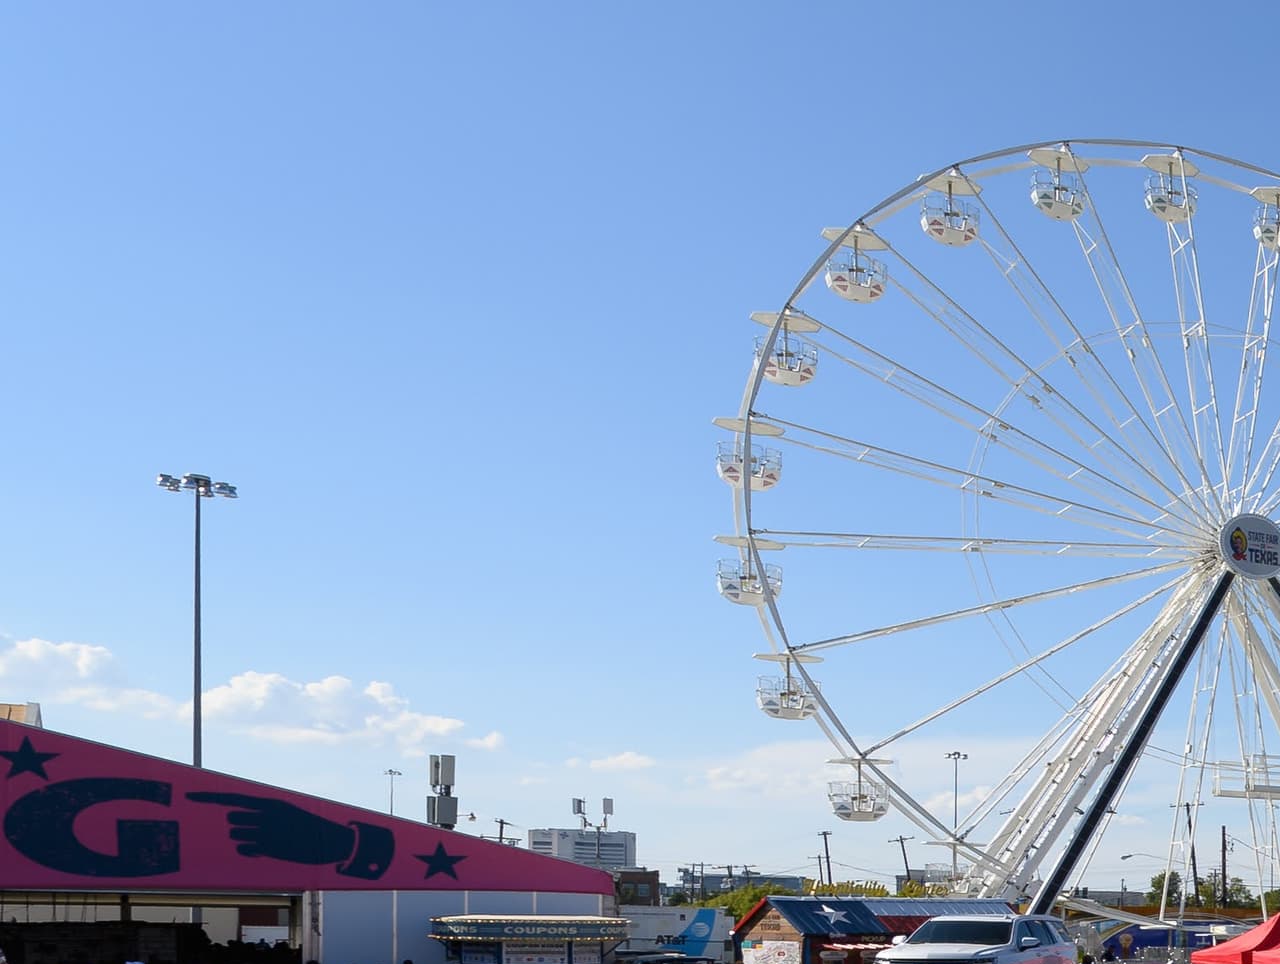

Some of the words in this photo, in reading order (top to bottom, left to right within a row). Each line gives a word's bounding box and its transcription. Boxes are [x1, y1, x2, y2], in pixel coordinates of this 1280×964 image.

[1247, 530, 1265, 543] STATE
[1265, 533, 1279, 545] FAIR
[1248, 548, 1280, 567] TEXAS
[801, 878, 890, 897] Hospitality
[503, 926, 578, 936] COUPONS
[655, 934, 689, 946] AT&T
